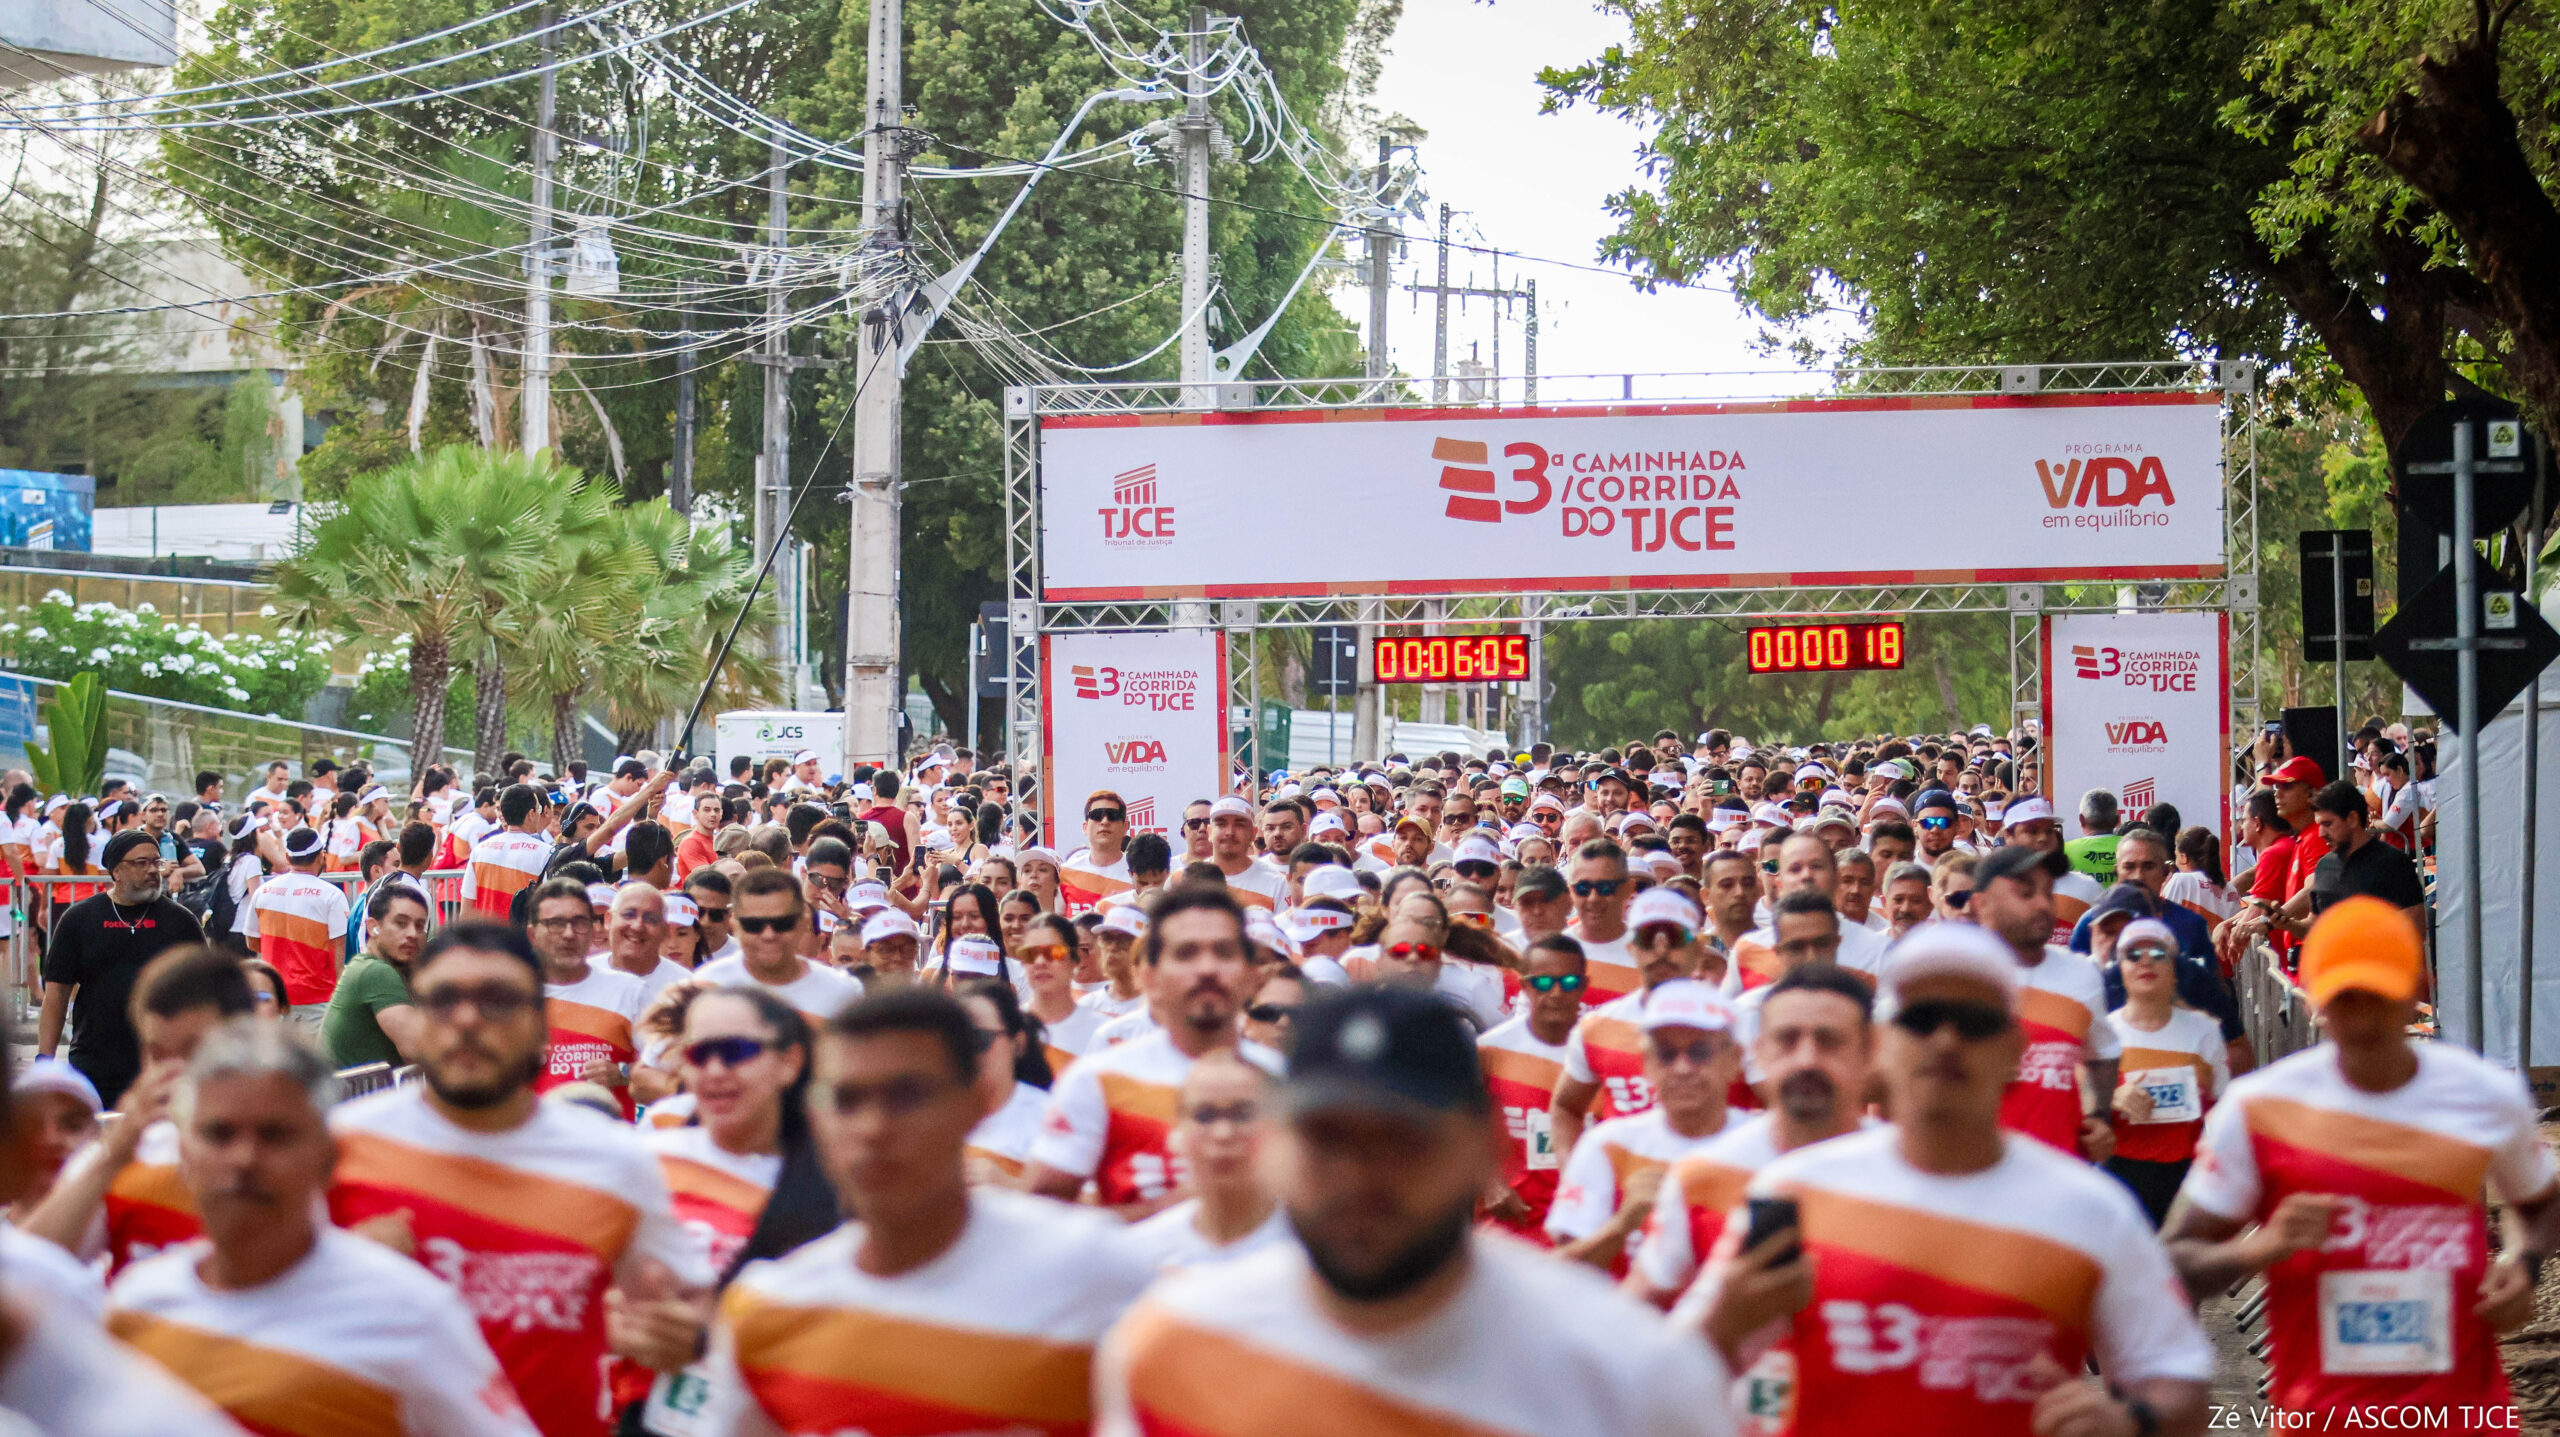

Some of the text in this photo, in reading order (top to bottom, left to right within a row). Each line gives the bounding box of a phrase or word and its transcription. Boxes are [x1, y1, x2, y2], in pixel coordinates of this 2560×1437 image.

[2065, 443, 2144, 454] PROGRAMA
[1572, 450, 1746, 473] CAMINHADA
[1561, 474, 1741, 503] /CORRIDA
[2035, 456, 2176, 509] VIDA
[1098, 507, 1175, 538] TJCE
[1562, 506, 1735, 552] DO TJCE
[2042, 509, 2169, 532] em equilíbrio
[1148, 539, 1173, 547] Justiça
[1378, 639, 1525, 678] 00:06:05
[2129, 651, 2201, 660] CAMINHADA
[1128, 670, 1198, 679] CAMINHADA
[2124, 661, 2198, 672] /CORRIDA
[1124, 680, 1196, 691] /CORRIDA
[2125, 673, 2196, 692] DO TJCE
[1124, 692, 1194, 711] DO TJCE
[777, 726, 803, 738] JCS
[2105, 721, 2168, 744] VIDA
[1105, 740, 1167, 764] VIDA
[304, 887, 321, 896] TJCE
[550, 1062, 571, 1075] DO
